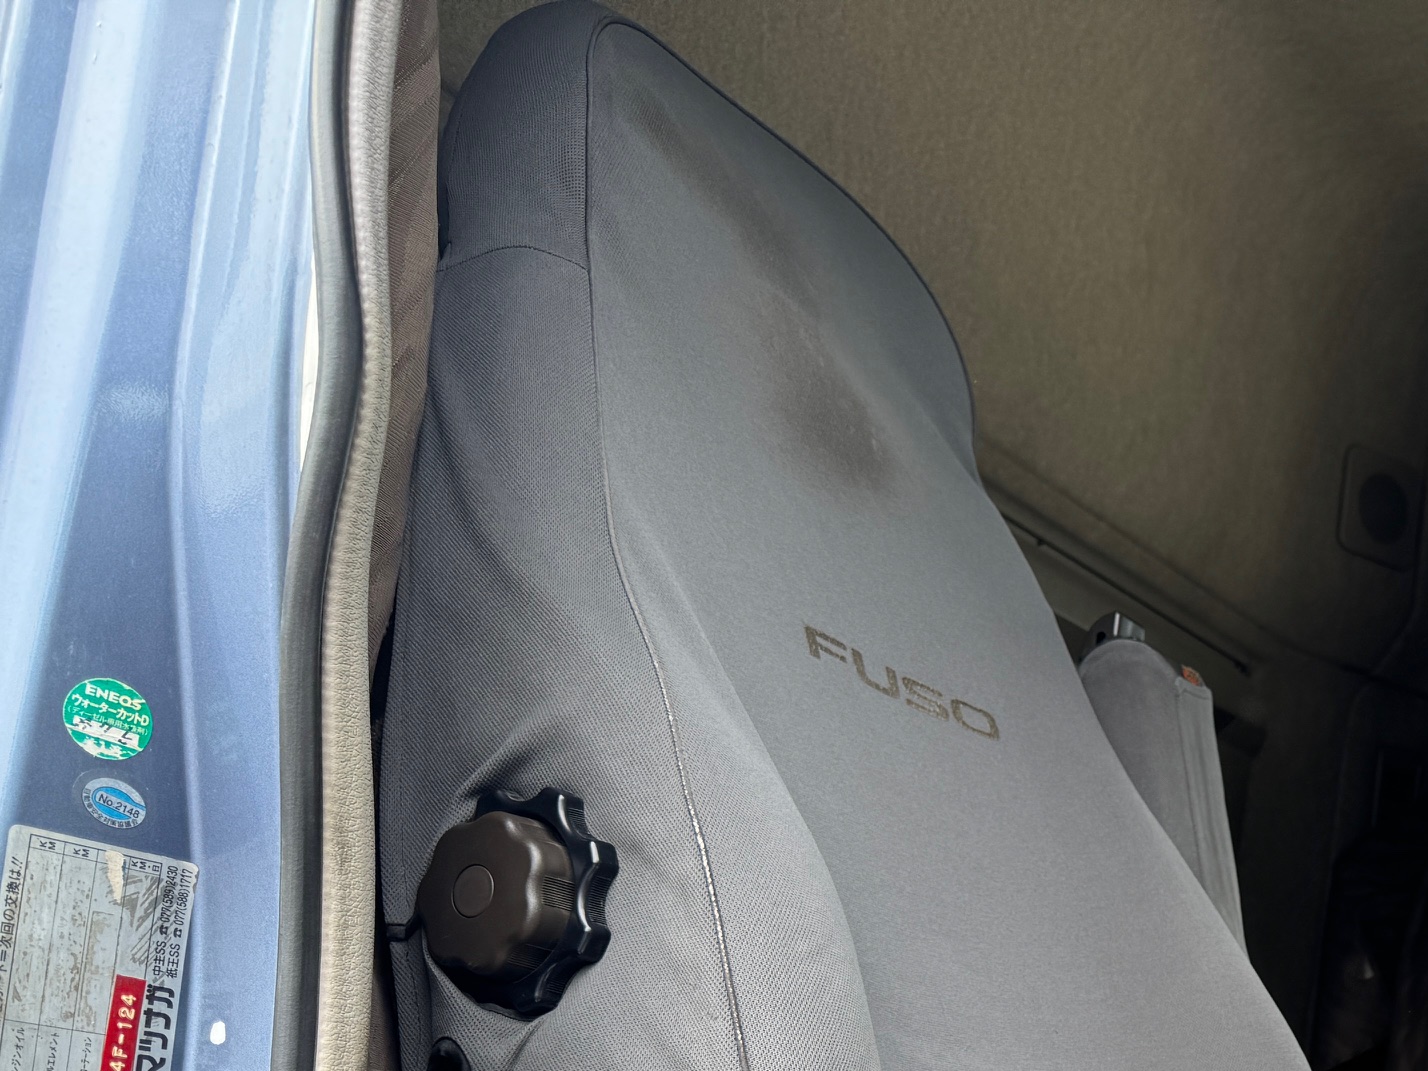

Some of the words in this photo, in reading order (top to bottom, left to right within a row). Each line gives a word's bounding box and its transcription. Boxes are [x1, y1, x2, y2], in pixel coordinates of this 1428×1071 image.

[85, 683, 142, 710] ENEOS
[804, 625, 1000, 741] FUSO
[72, 694, 149, 726] ウォーターカットD
